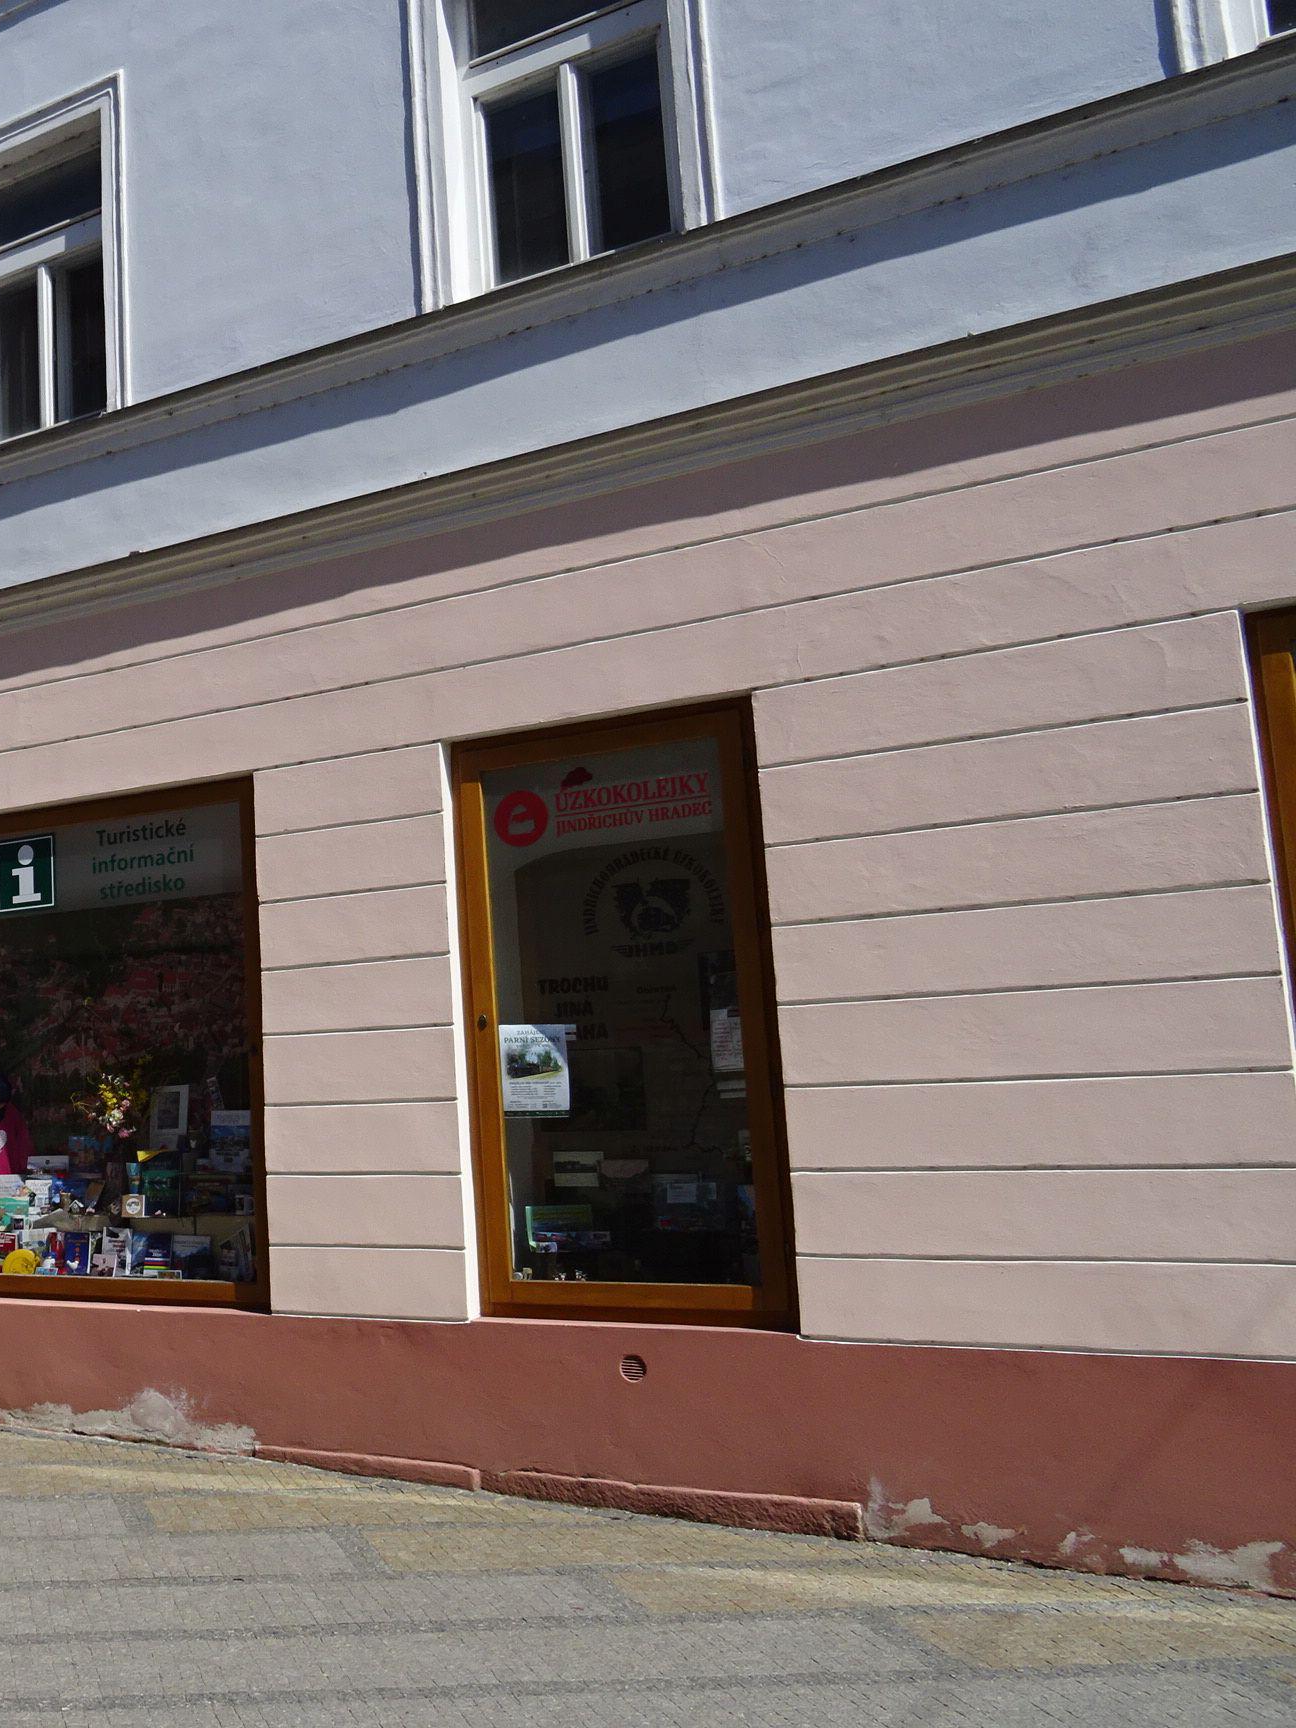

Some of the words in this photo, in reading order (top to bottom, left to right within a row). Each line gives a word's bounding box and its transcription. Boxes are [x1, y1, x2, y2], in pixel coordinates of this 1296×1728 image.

[556, 772, 709, 813] ÚZKOKOLEJKY
[96, 818, 186, 846] Turistické
[556, 808, 644, 839] JINDŘICHŮV
[648, 800, 712, 823] HRADEC
[92, 843, 194, 874] informační
[100, 874, 185, 900] středisko
[504, 1036, 527, 1044] PARNÍ
